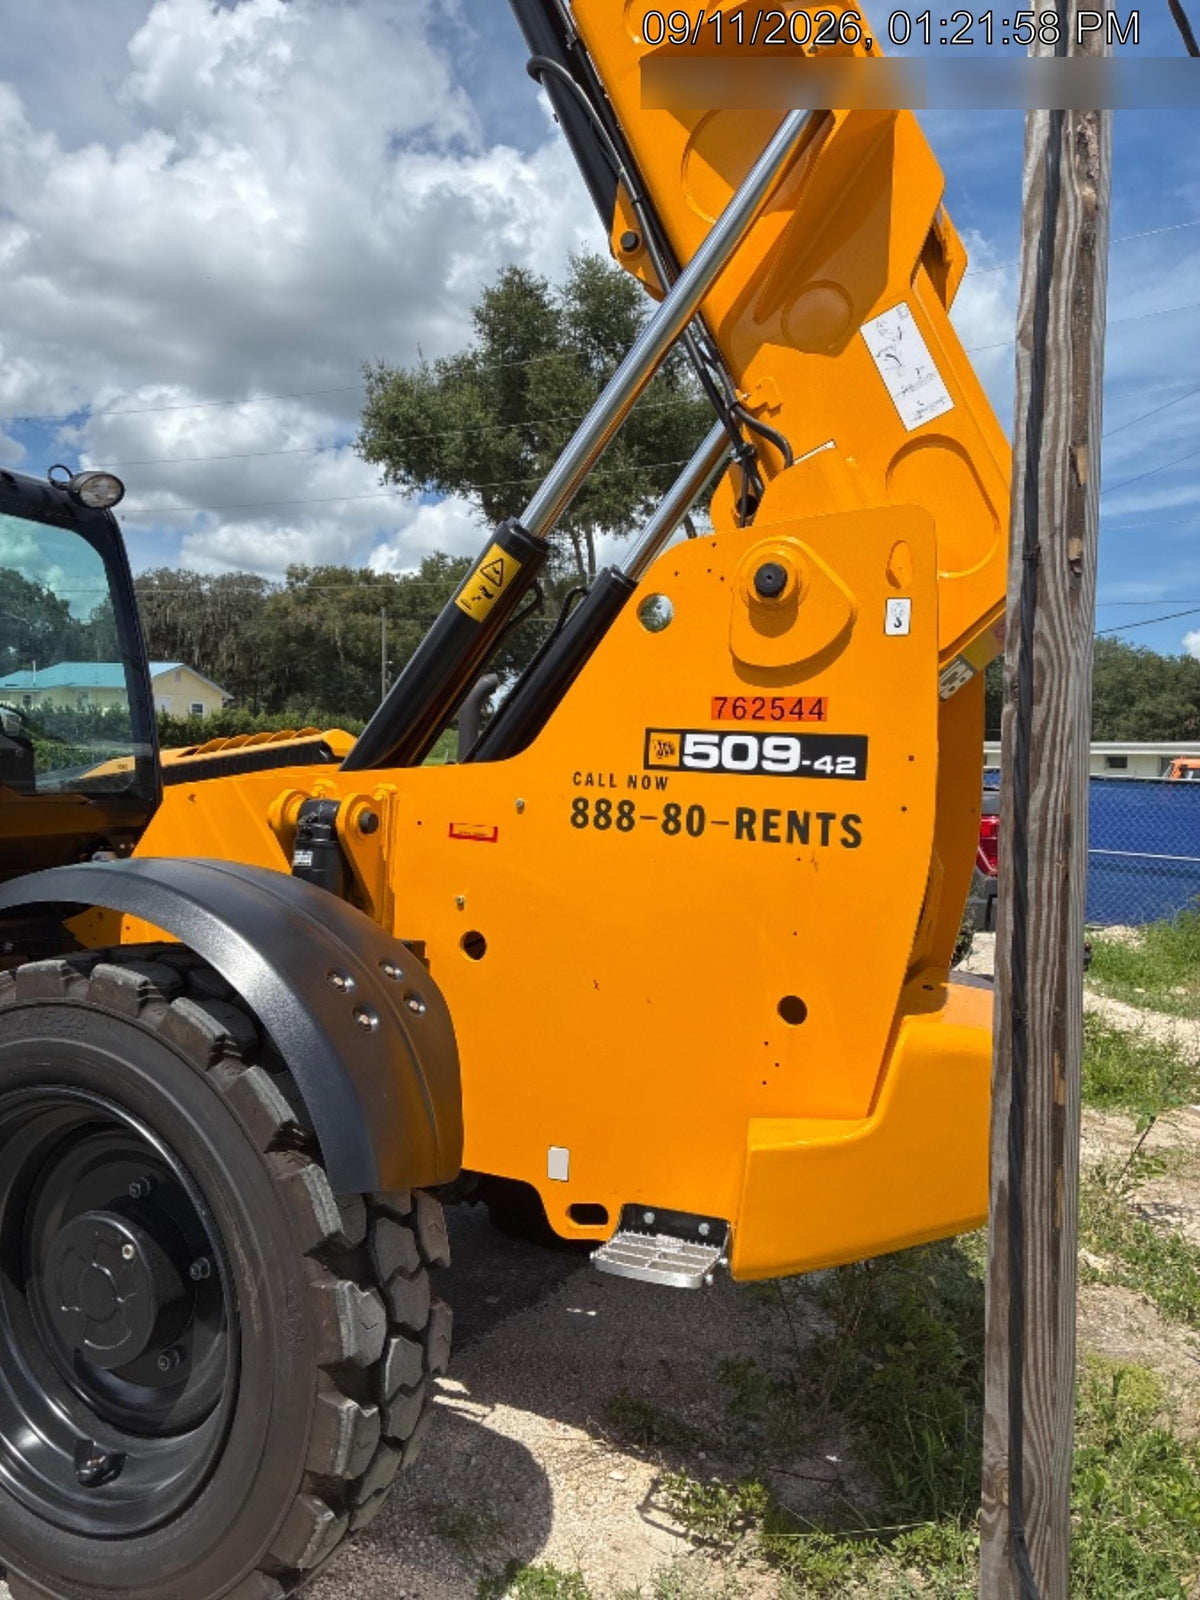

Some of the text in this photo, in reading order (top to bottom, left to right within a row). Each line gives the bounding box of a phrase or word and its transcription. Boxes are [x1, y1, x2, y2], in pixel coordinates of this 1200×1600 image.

[713, 697, 825, 721] 762544
[682, 733, 857, 775] 509-42
[572, 771, 669, 791] CALL NOW
[570, 797, 863, 849] 888-80-RENTS
